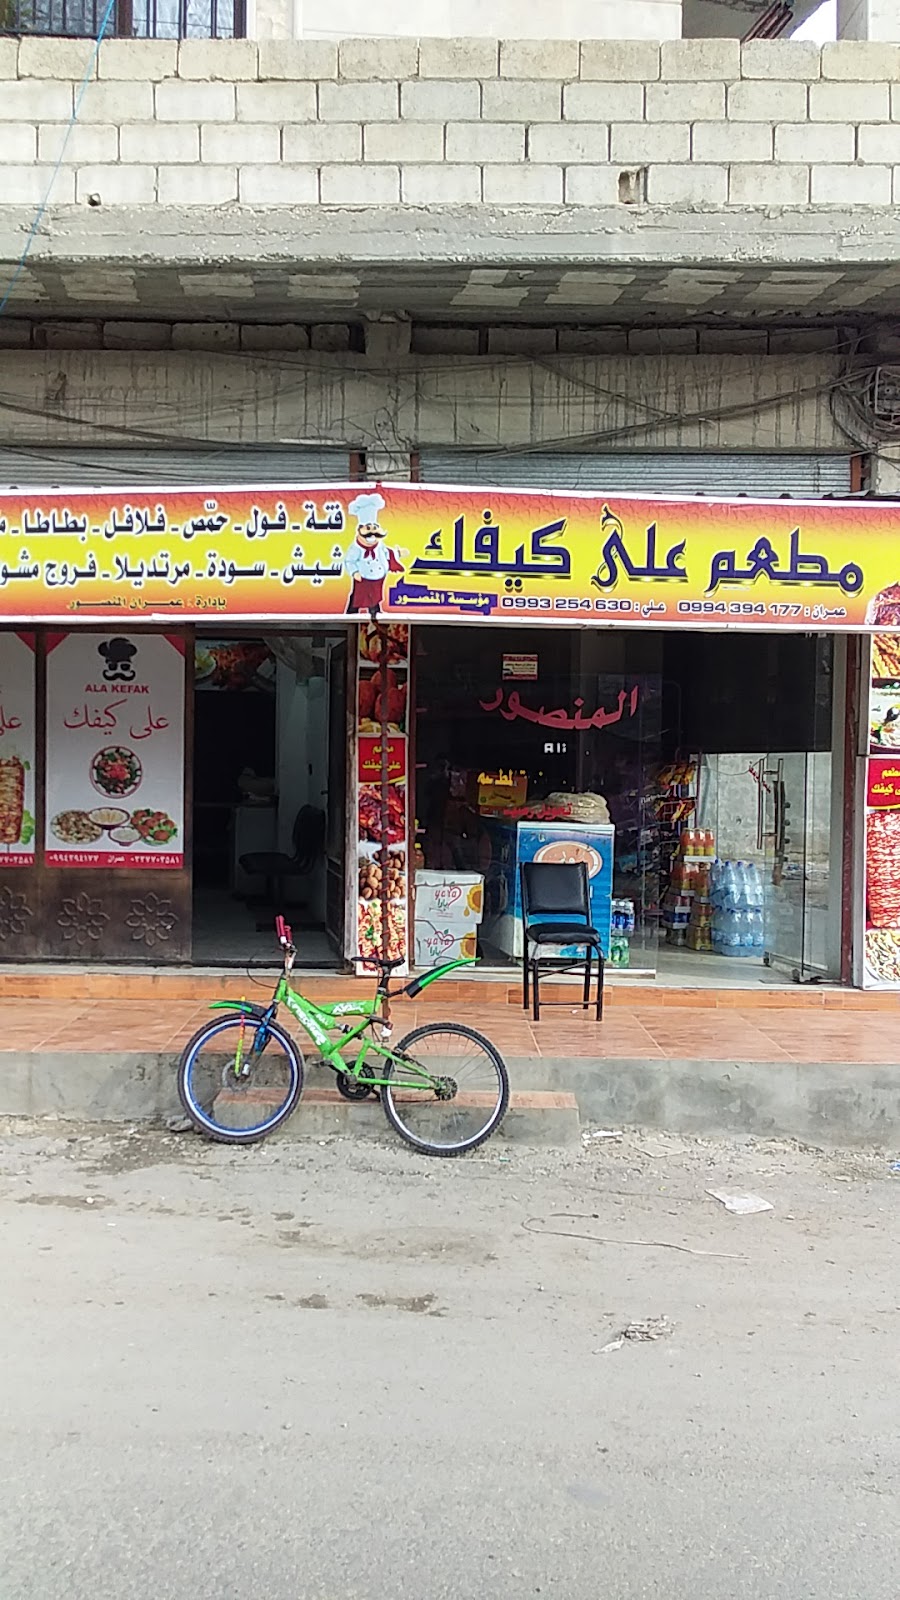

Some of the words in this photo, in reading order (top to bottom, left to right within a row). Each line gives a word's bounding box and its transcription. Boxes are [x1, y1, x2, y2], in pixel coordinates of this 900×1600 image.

[25, 510, 86, 541] بطاطا
[104, 507, 165, 538] فلافل
[246, 504, 287, 538] فول
[305, 503, 343, 530] فتة
[283, 546, 343, 584] شيش
[410, 511, 572, 592] كيفك
[704, 527, 864, 596] مطعم
[45, 553, 97, 585] فروج
[114, 553, 190, 586] مرتديلا
[207, 552, 265, 583] سودة
[68, 597, 126, 610] المنصور
[129, 598, 183, 609] عمران
[394, 591, 445, 605] المنصور
[447, 592, 490, 607] مؤسسة
[502, 597, 551, 608] 0993
[555, 598, 591, 609] 254
[595, 599, 631, 610] 630
[678, 601, 726, 612] 0994
[729, 602, 765, 614] 394
[770, 604, 801, 616] 177
[85, 684, 107, 693] ALA
[111, 684, 150, 694] KEFAK
[64, 698, 128, 736] كيفك
[130, 704, 169, 739] على
[479, 685, 639, 730] المنصور
